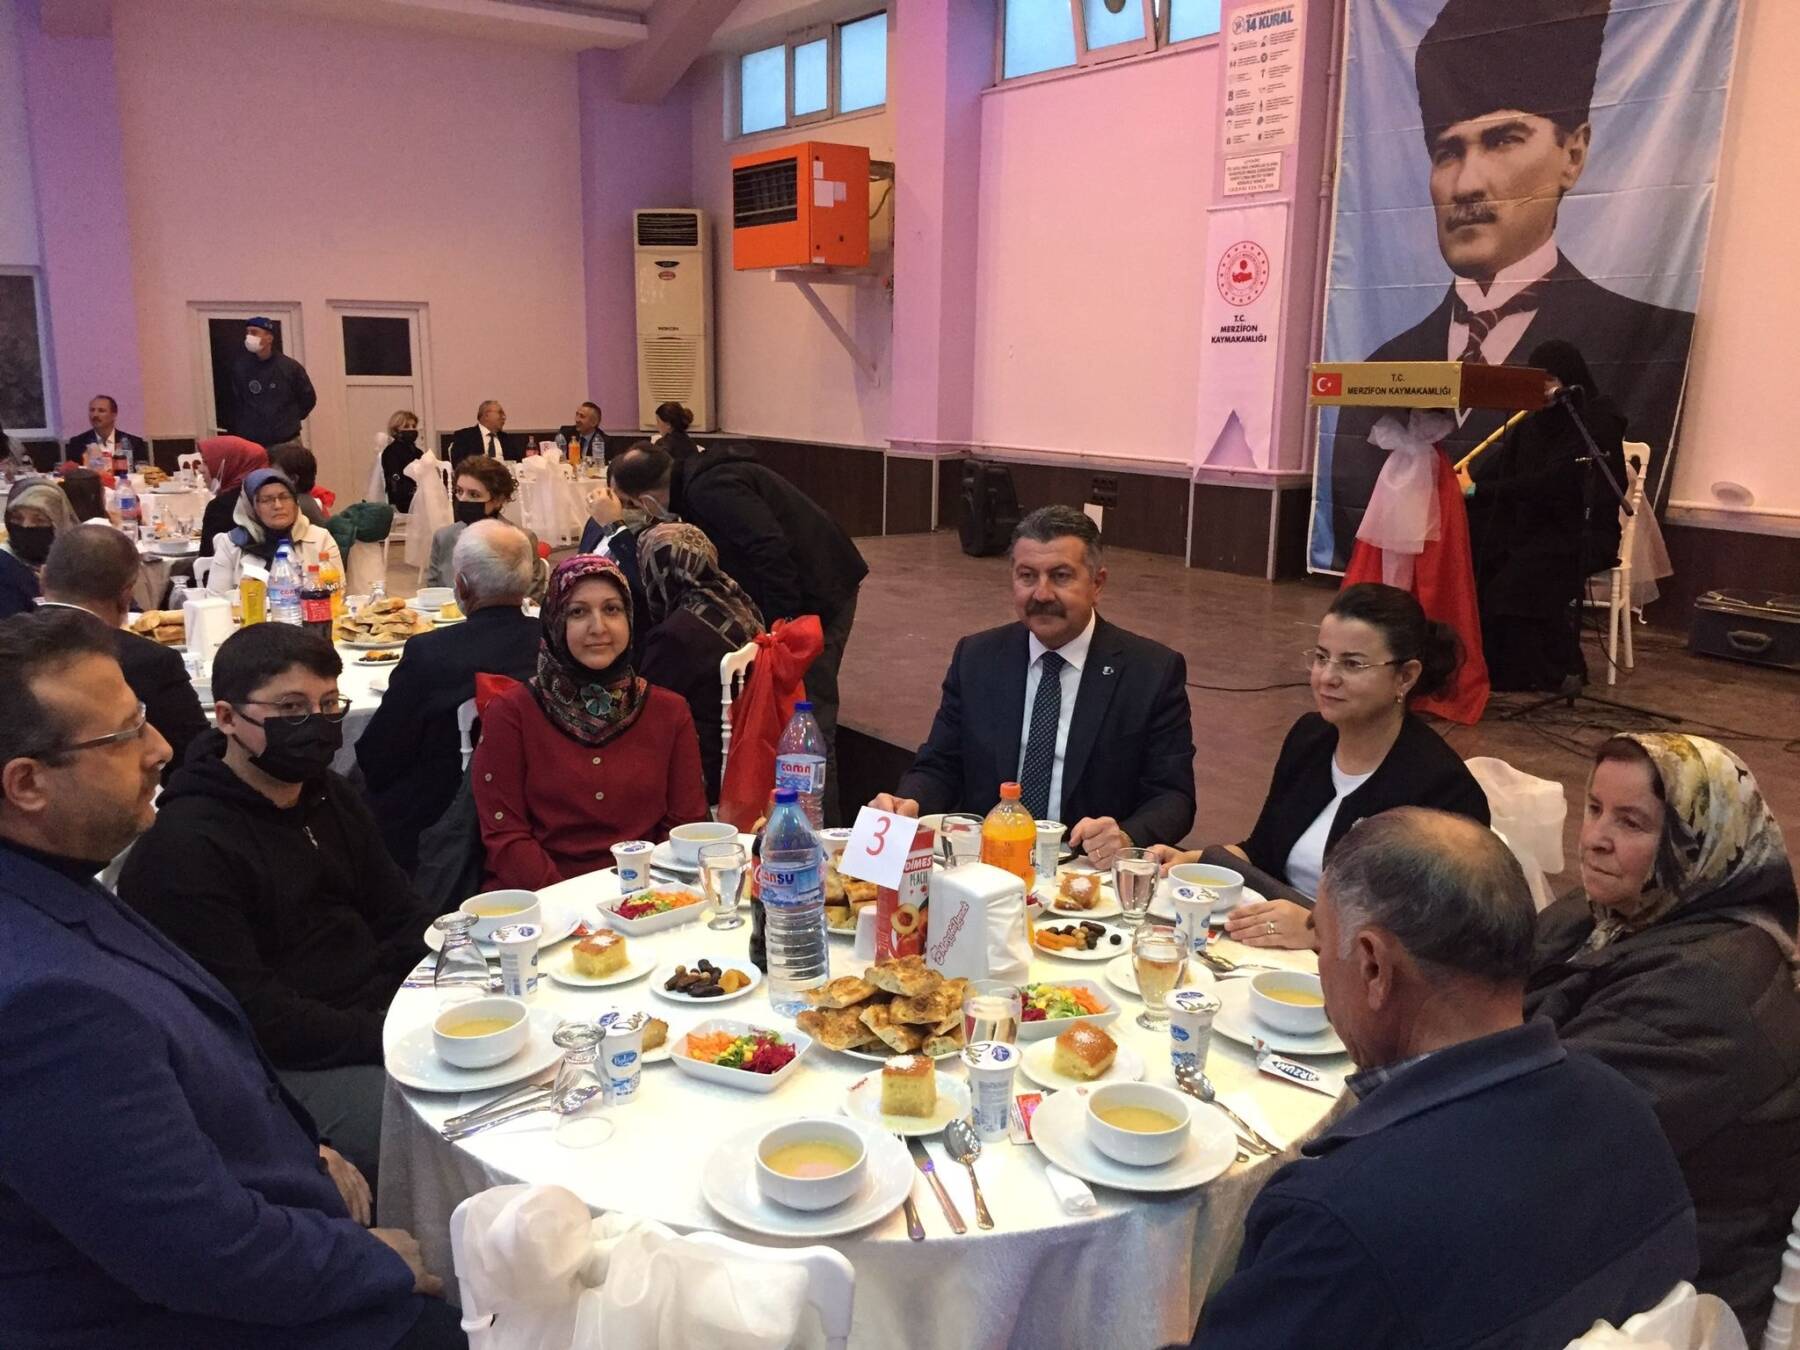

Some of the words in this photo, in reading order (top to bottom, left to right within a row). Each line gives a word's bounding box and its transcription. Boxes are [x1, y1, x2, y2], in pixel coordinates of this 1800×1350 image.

[1246, 18, 1257, 32] 14
[1258, 10, 1294, 30] KURAL
[1220, 324, 1258, 333] MERZİFON
[1211, 334, 1267, 343] KAYMAKAMLIĞI
[1391, 374, 1406, 382] T.C.
[1347, 386, 1387, 395] MERZİFON
[1388, 386, 1452, 396] KAYMAKAMLIĞI
[865, 815, 892, 856] 3
